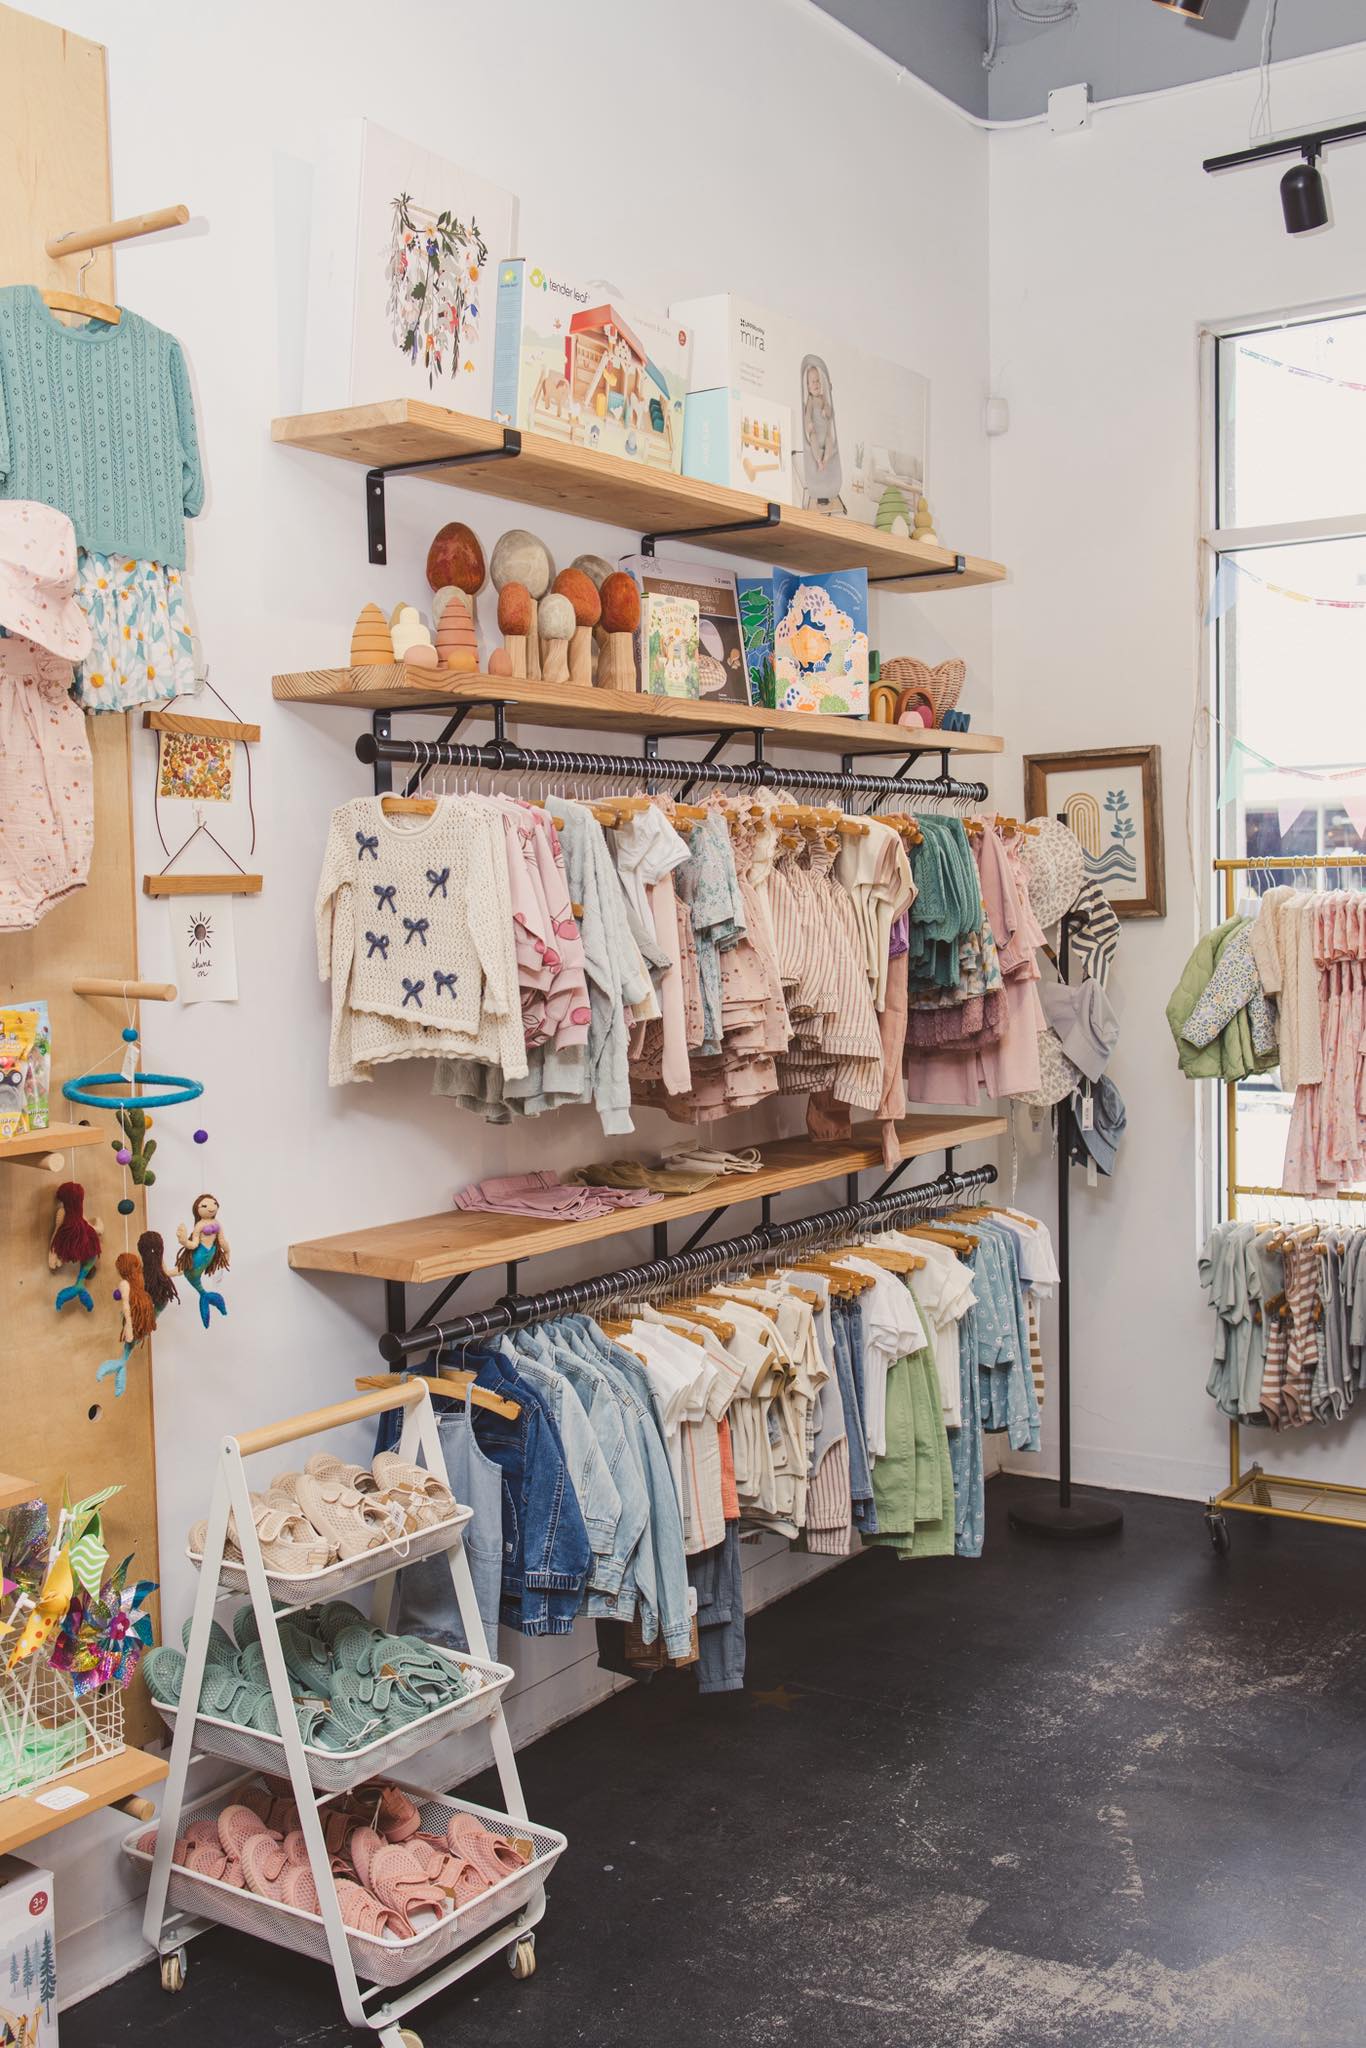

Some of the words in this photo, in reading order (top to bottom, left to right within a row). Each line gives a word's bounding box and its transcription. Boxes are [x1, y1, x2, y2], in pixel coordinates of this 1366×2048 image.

[549, 277, 573, 297] tender
[573, 287, 588, 304] leaf
[740, 329, 766, 352] mira
[32, 1897, 45, 1909] 3+
